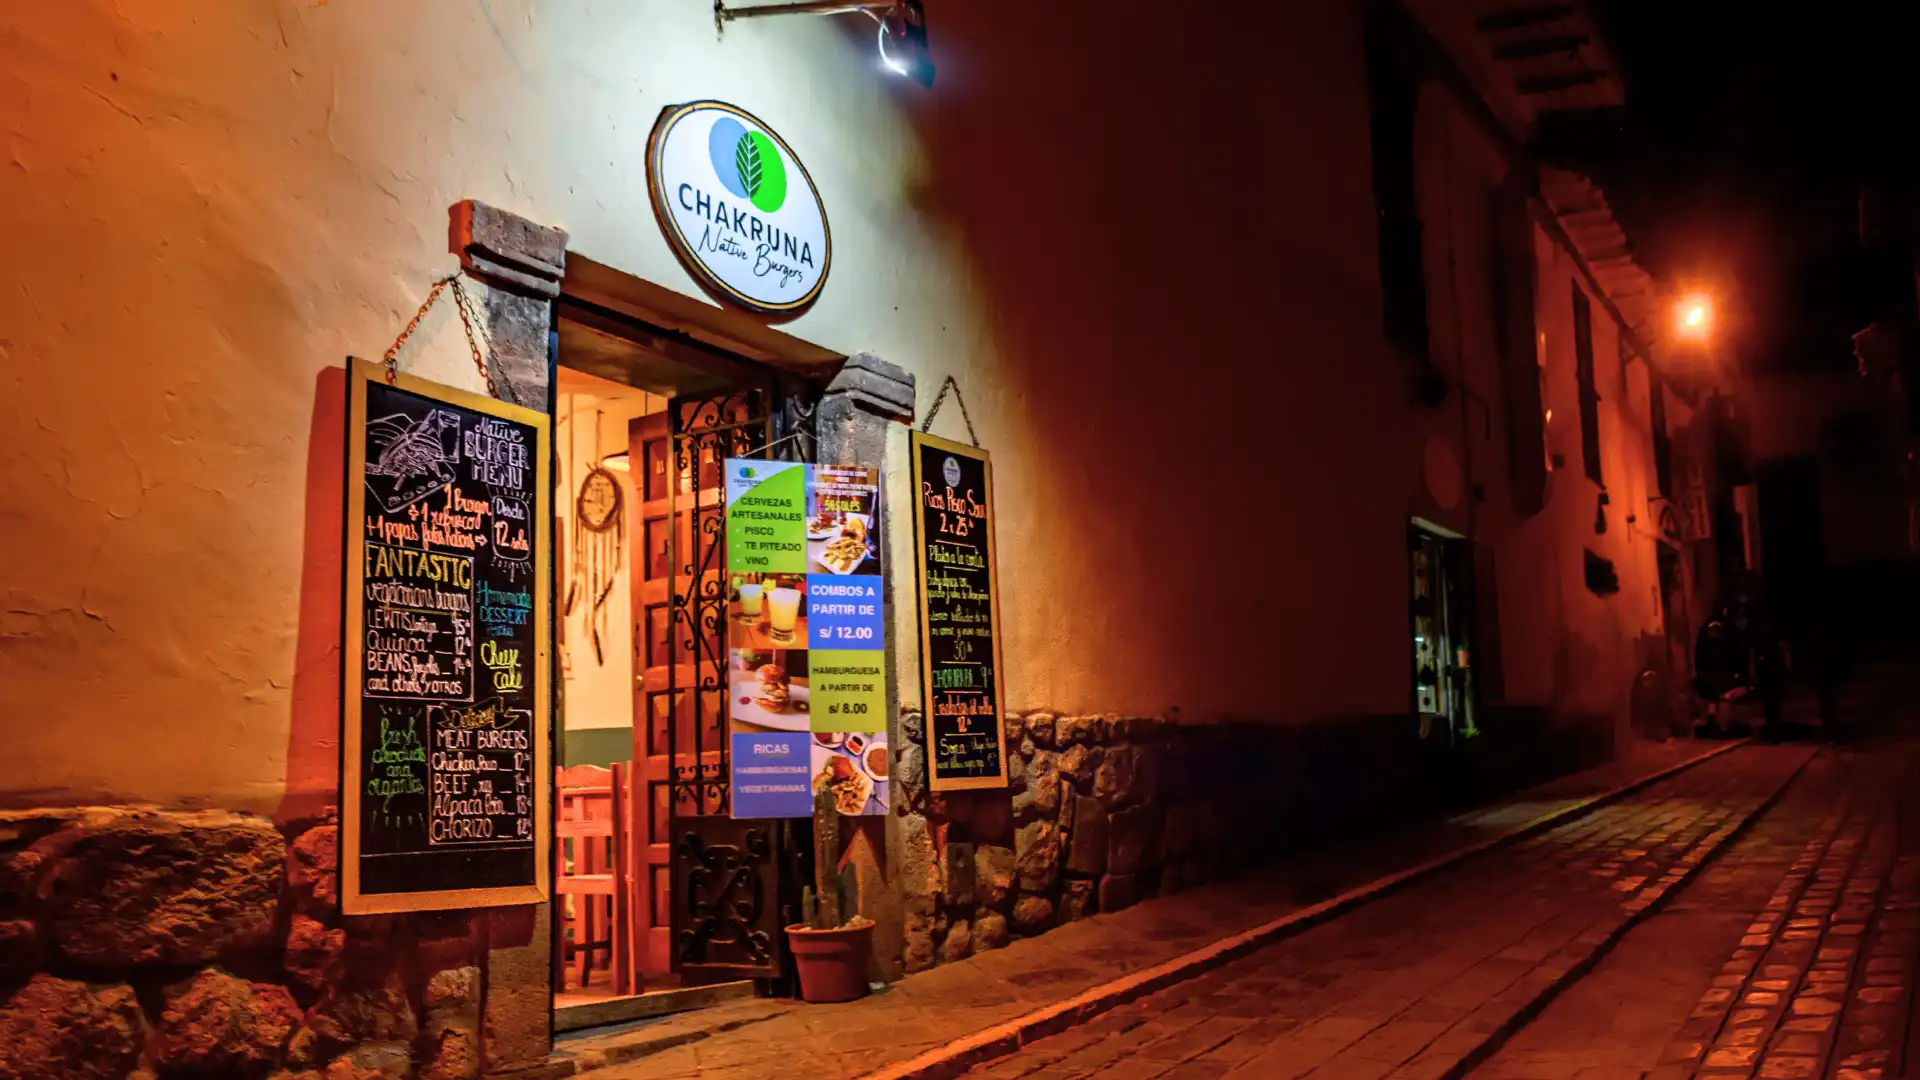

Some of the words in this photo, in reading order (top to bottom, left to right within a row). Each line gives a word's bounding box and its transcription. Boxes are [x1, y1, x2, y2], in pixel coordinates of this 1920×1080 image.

[678, 183, 814, 269] CHAKRUNA
[699, 223, 748, 260] Native
[753, 243, 803, 288] Burgers
[474, 416, 524, 443] Native
[464, 430, 530, 470] BURGER
[472, 458, 523, 490] MENU
[444, 483, 452, 509] 1
[740, 497, 792, 508] CERVEZAS
[731, 510, 802, 522] ARTESANALES
[940, 512, 949, 533] 2
[385, 522, 420, 548] papas
[494, 520, 510, 546] 12
[744, 526, 775, 536] PISCO
[745, 541, 758, 550] TE
[759, 542, 802, 552] PITEADO
[365, 545, 471, 589] FANTASTIC
[745, 556, 769, 566] VINO
[811, 585, 864, 597] COMBOS
[866, 586, 875, 597] A
[480, 605, 529, 625] DESSERT
[812, 603, 856, 615] PARTIR
[858, 604, 875, 616] DE
[367, 630, 428, 653] Quinoa
[836, 627, 873, 640] 12.00
[812, 666, 881, 676] HAMBURGUESA
[820, 684, 827, 692] A
[829, 684, 860, 692] PARTIR
[862, 684, 874, 692] DE
[842, 703, 868, 714] 8.00
[436, 729, 472, 748] MEAT
[477, 730, 528, 749] BURGERS
[753, 743, 790, 755] RICAS
[739, 784, 807, 793] VEGETARIANAS
[432, 793, 484, 821] Alpaca
[431, 817, 494, 841] CHORIZO
